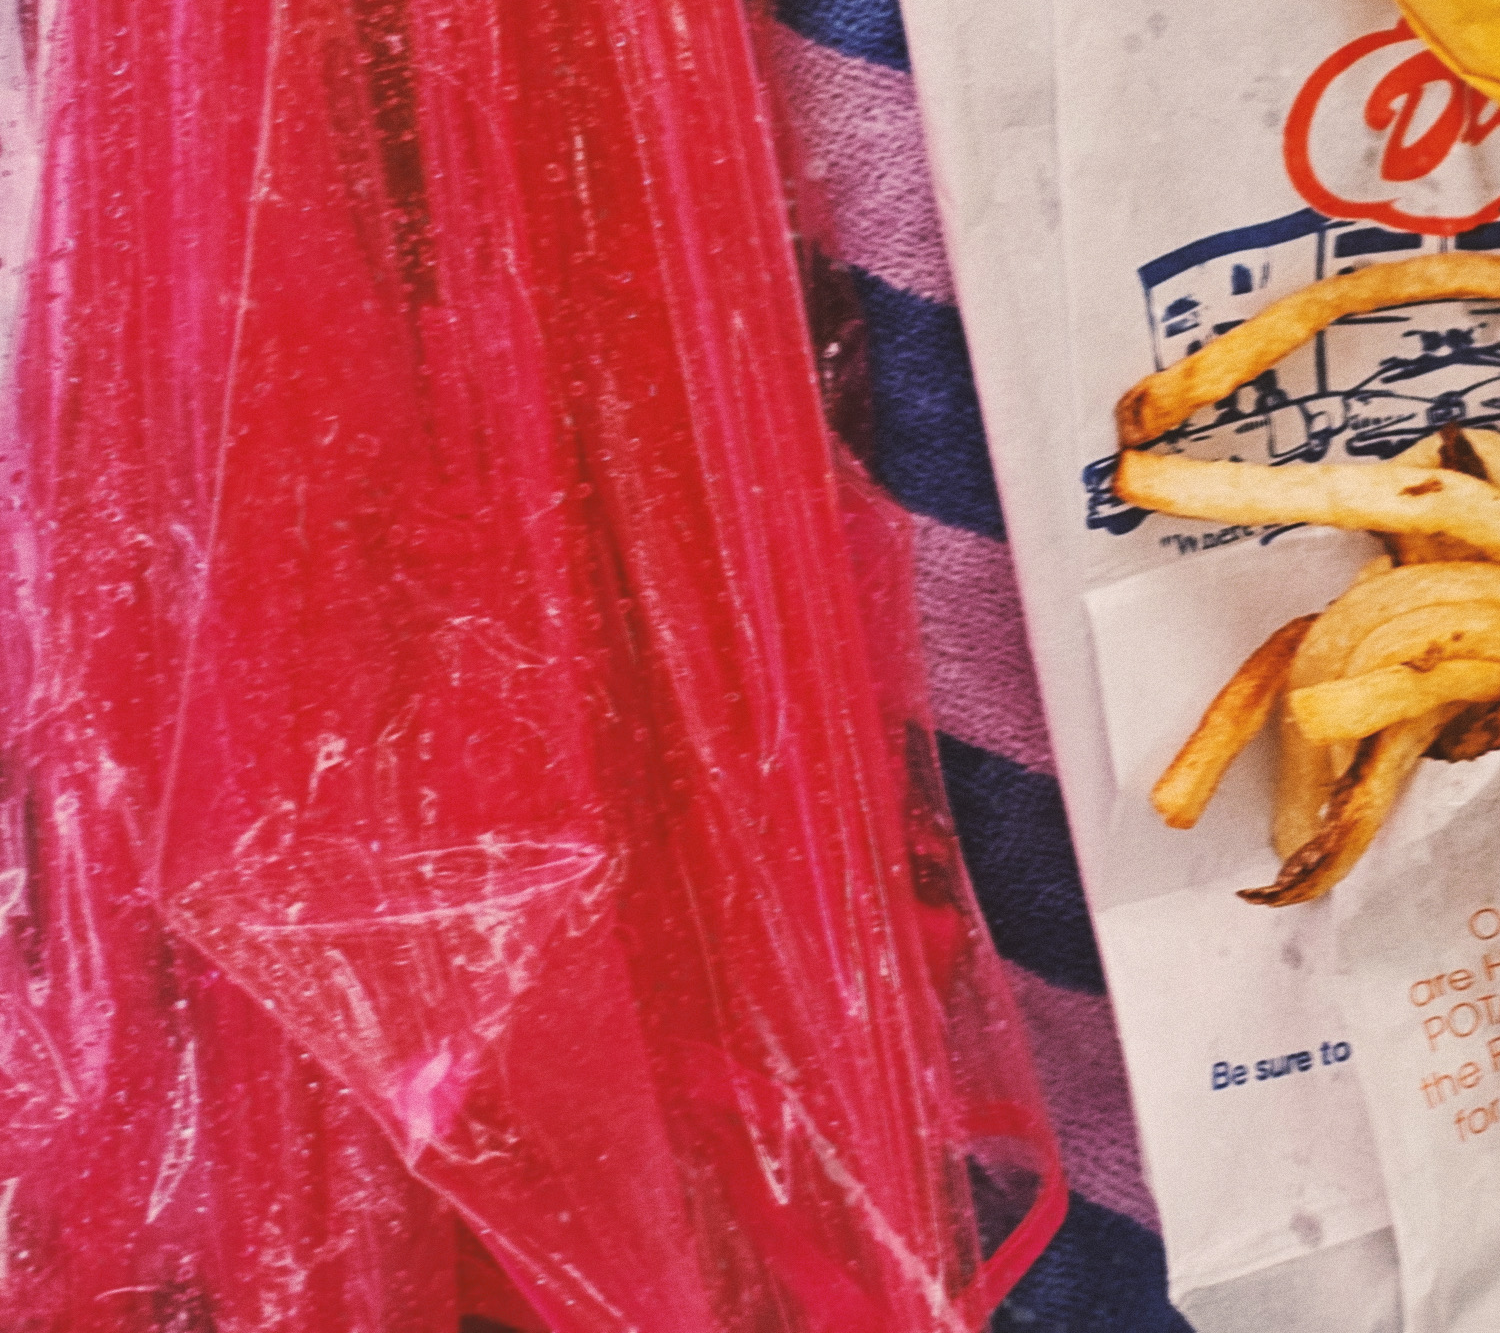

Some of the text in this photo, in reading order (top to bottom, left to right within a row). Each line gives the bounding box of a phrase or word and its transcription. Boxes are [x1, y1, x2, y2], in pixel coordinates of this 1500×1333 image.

[1409, 969, 1475, 1008] are
[1212, 1040, 1353, 1091] Be sure to
[1420, 1060, 1483, 1109] the
[1454, 1097, 1500, 1142] for
